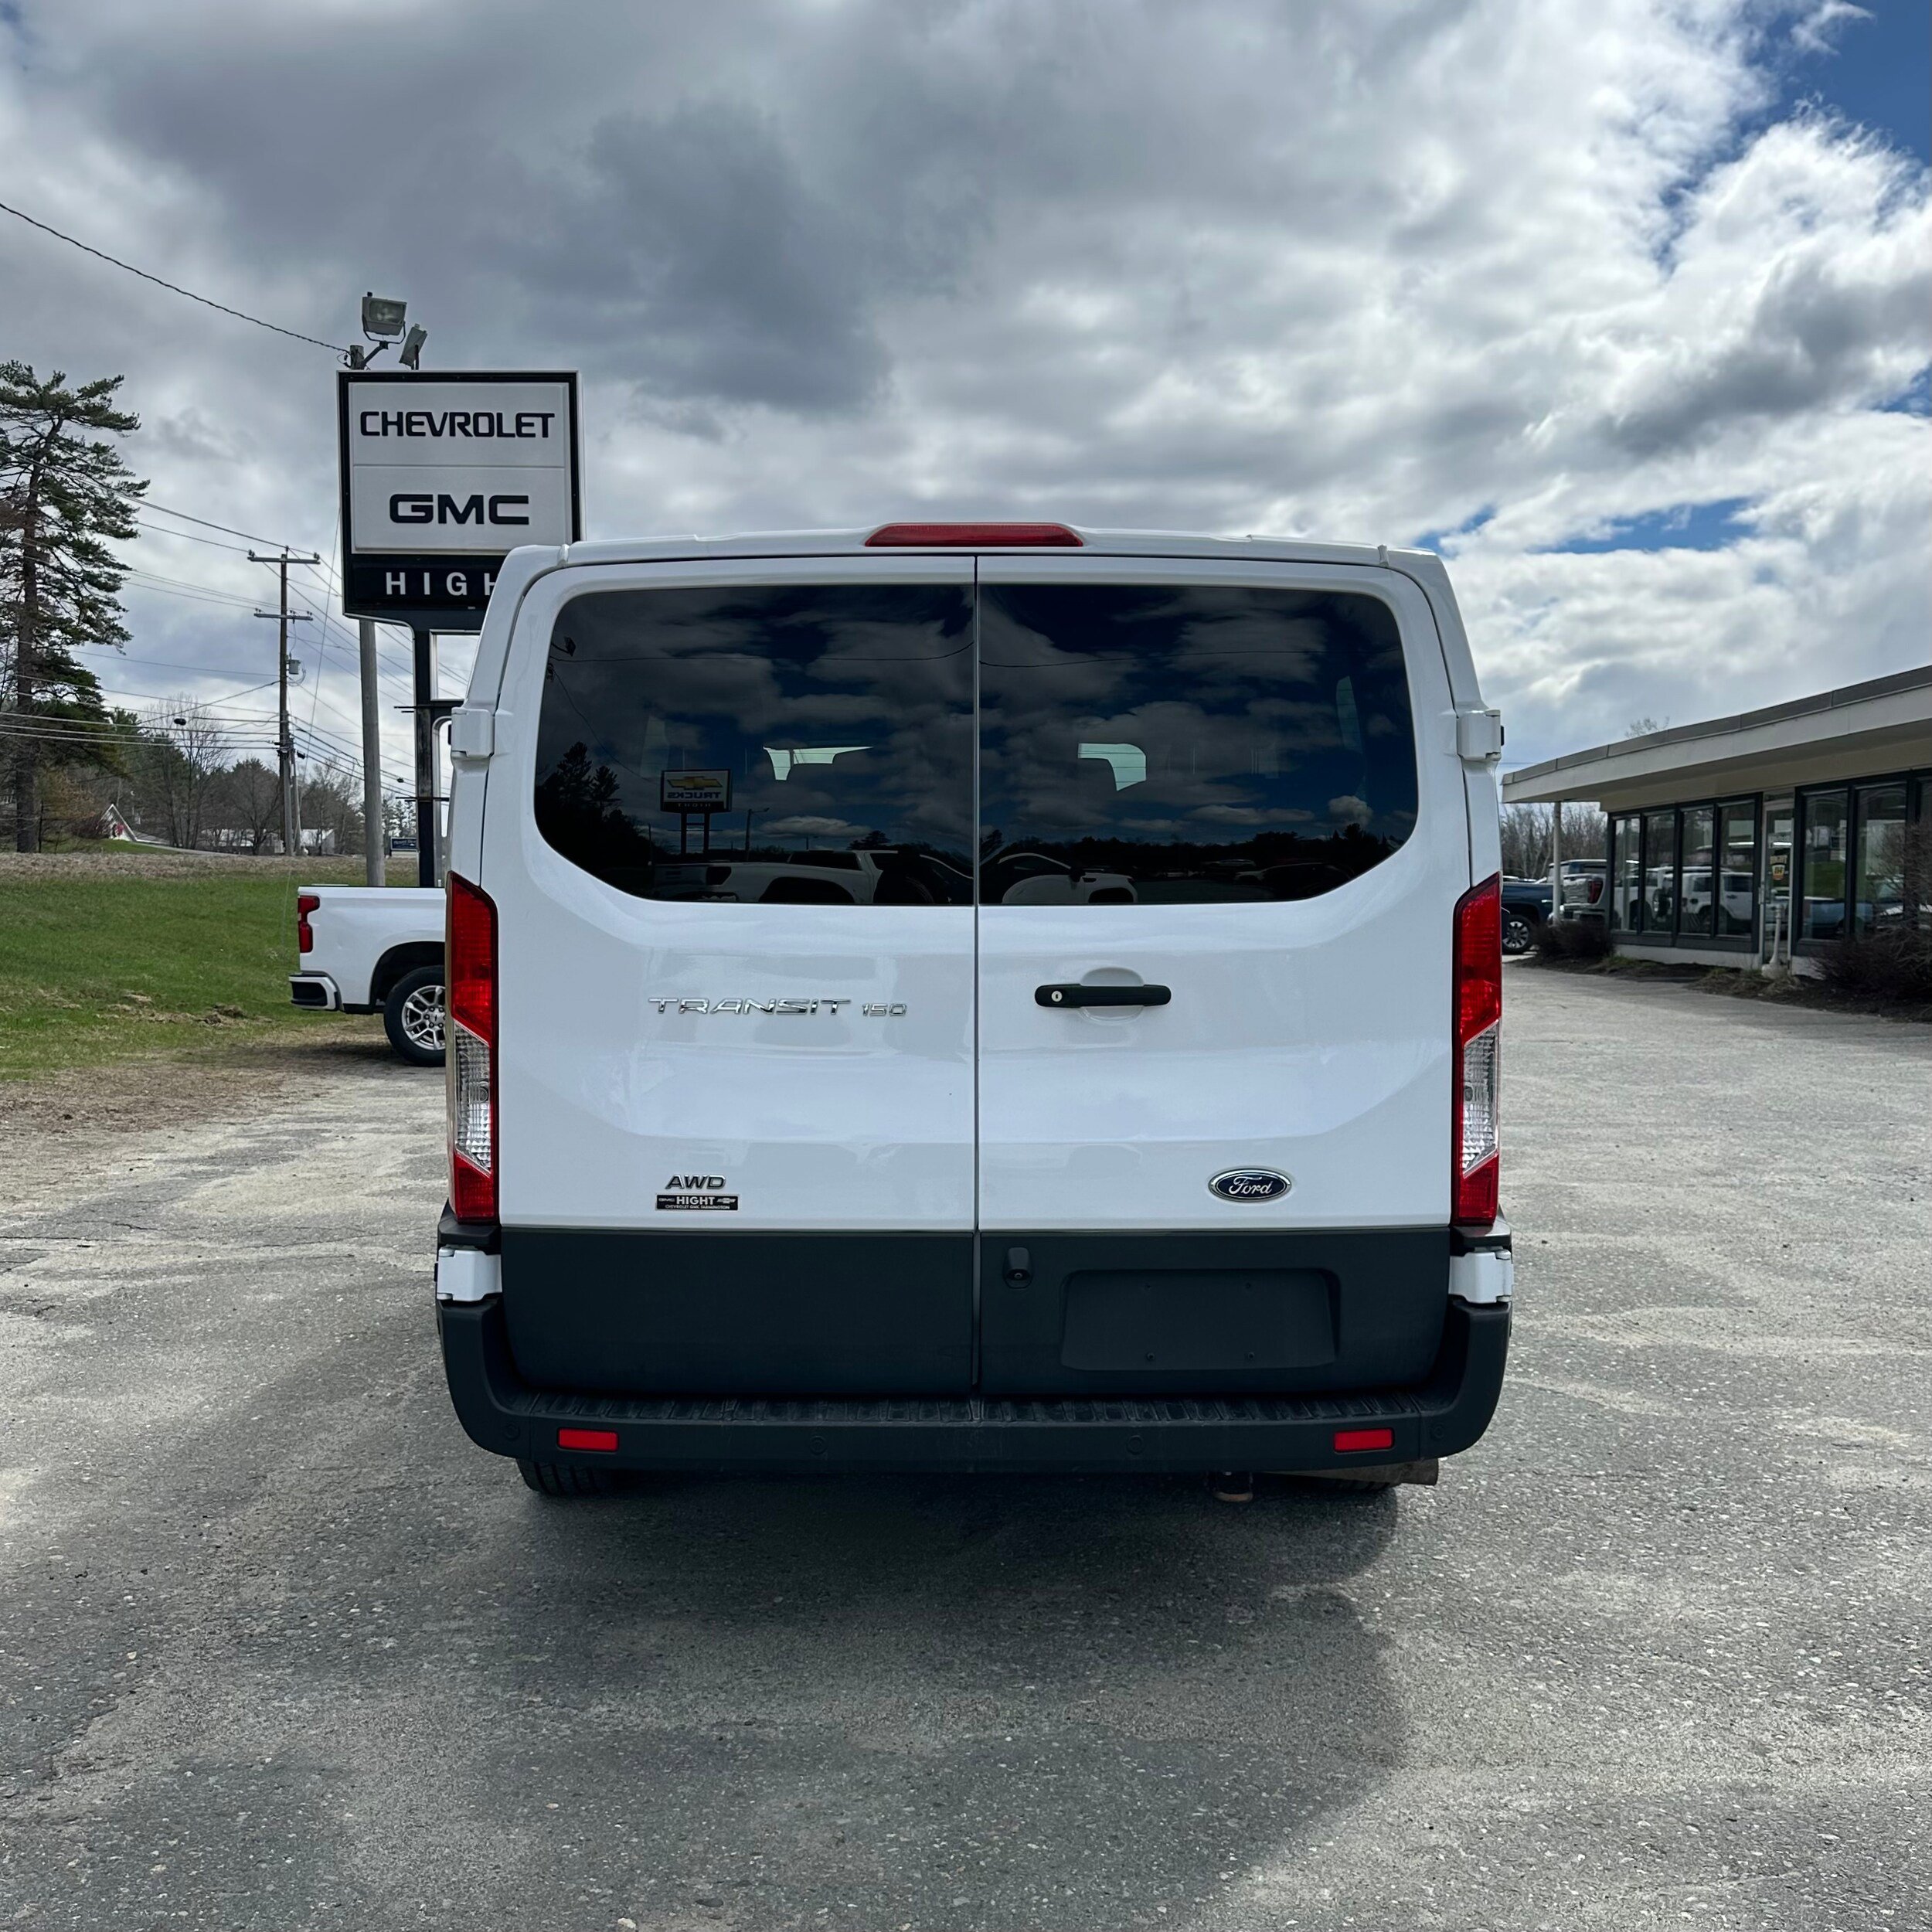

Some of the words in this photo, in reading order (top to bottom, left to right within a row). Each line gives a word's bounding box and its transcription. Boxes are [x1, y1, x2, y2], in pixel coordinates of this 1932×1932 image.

[360, 411, 555, 438] CHEVROLET
[389, 494, 529, 526] GMC
[648, 998, 852, 1015] TRANSIT
[862, 1004, 907, 1016] 150
[665, 1175, 726, 1189] AWD
[1228, 1176, 1273, 1195] Ford
[676, 1196, 715, 1205] HIGHT
